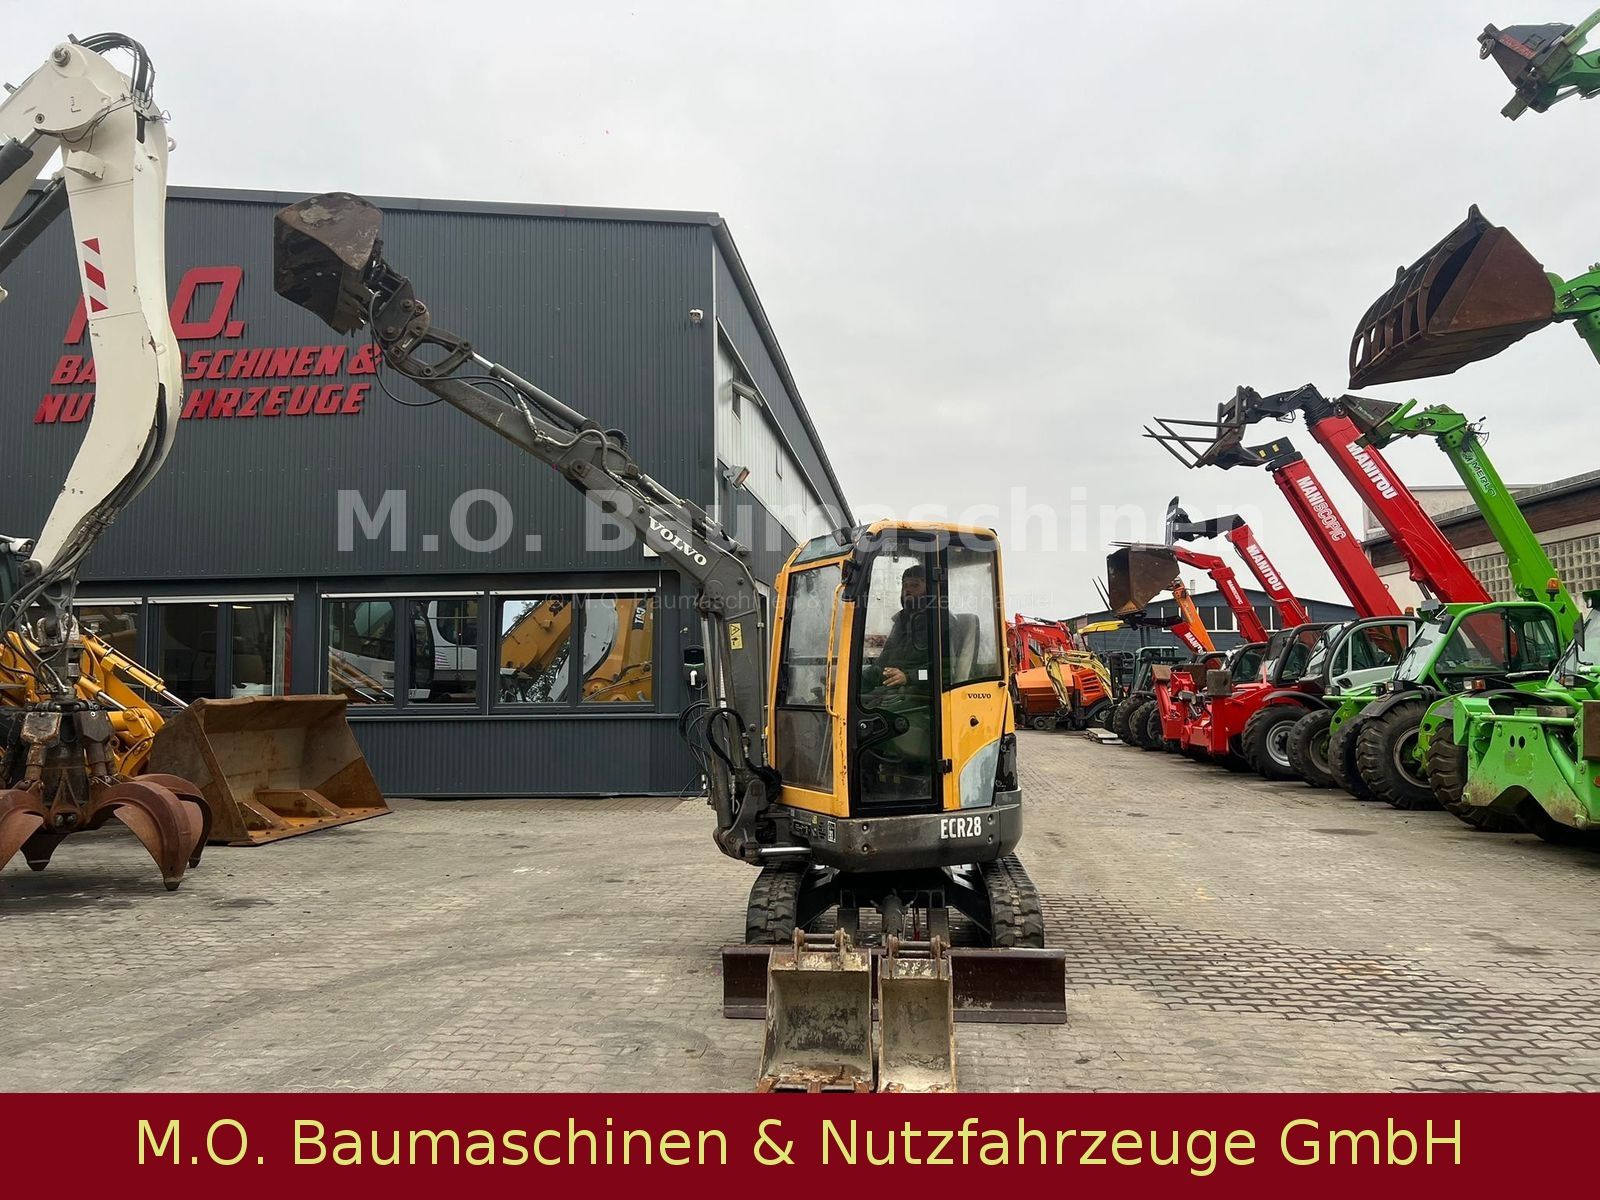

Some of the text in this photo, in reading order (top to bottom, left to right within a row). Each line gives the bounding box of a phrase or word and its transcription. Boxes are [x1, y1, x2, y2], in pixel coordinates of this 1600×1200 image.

[347, 343, 382, 374] &
[1345, 441, 1399, 500] MANITOU
[1471, 459, 1497, 497] MERLO
[1296, 475, 1347, 542] MANISCOPIC
[648, 515, 707, 566] VOLVO
[1246, 543, 1285, 592] MANITOU
[940, 814, 982, 840] ECR28
